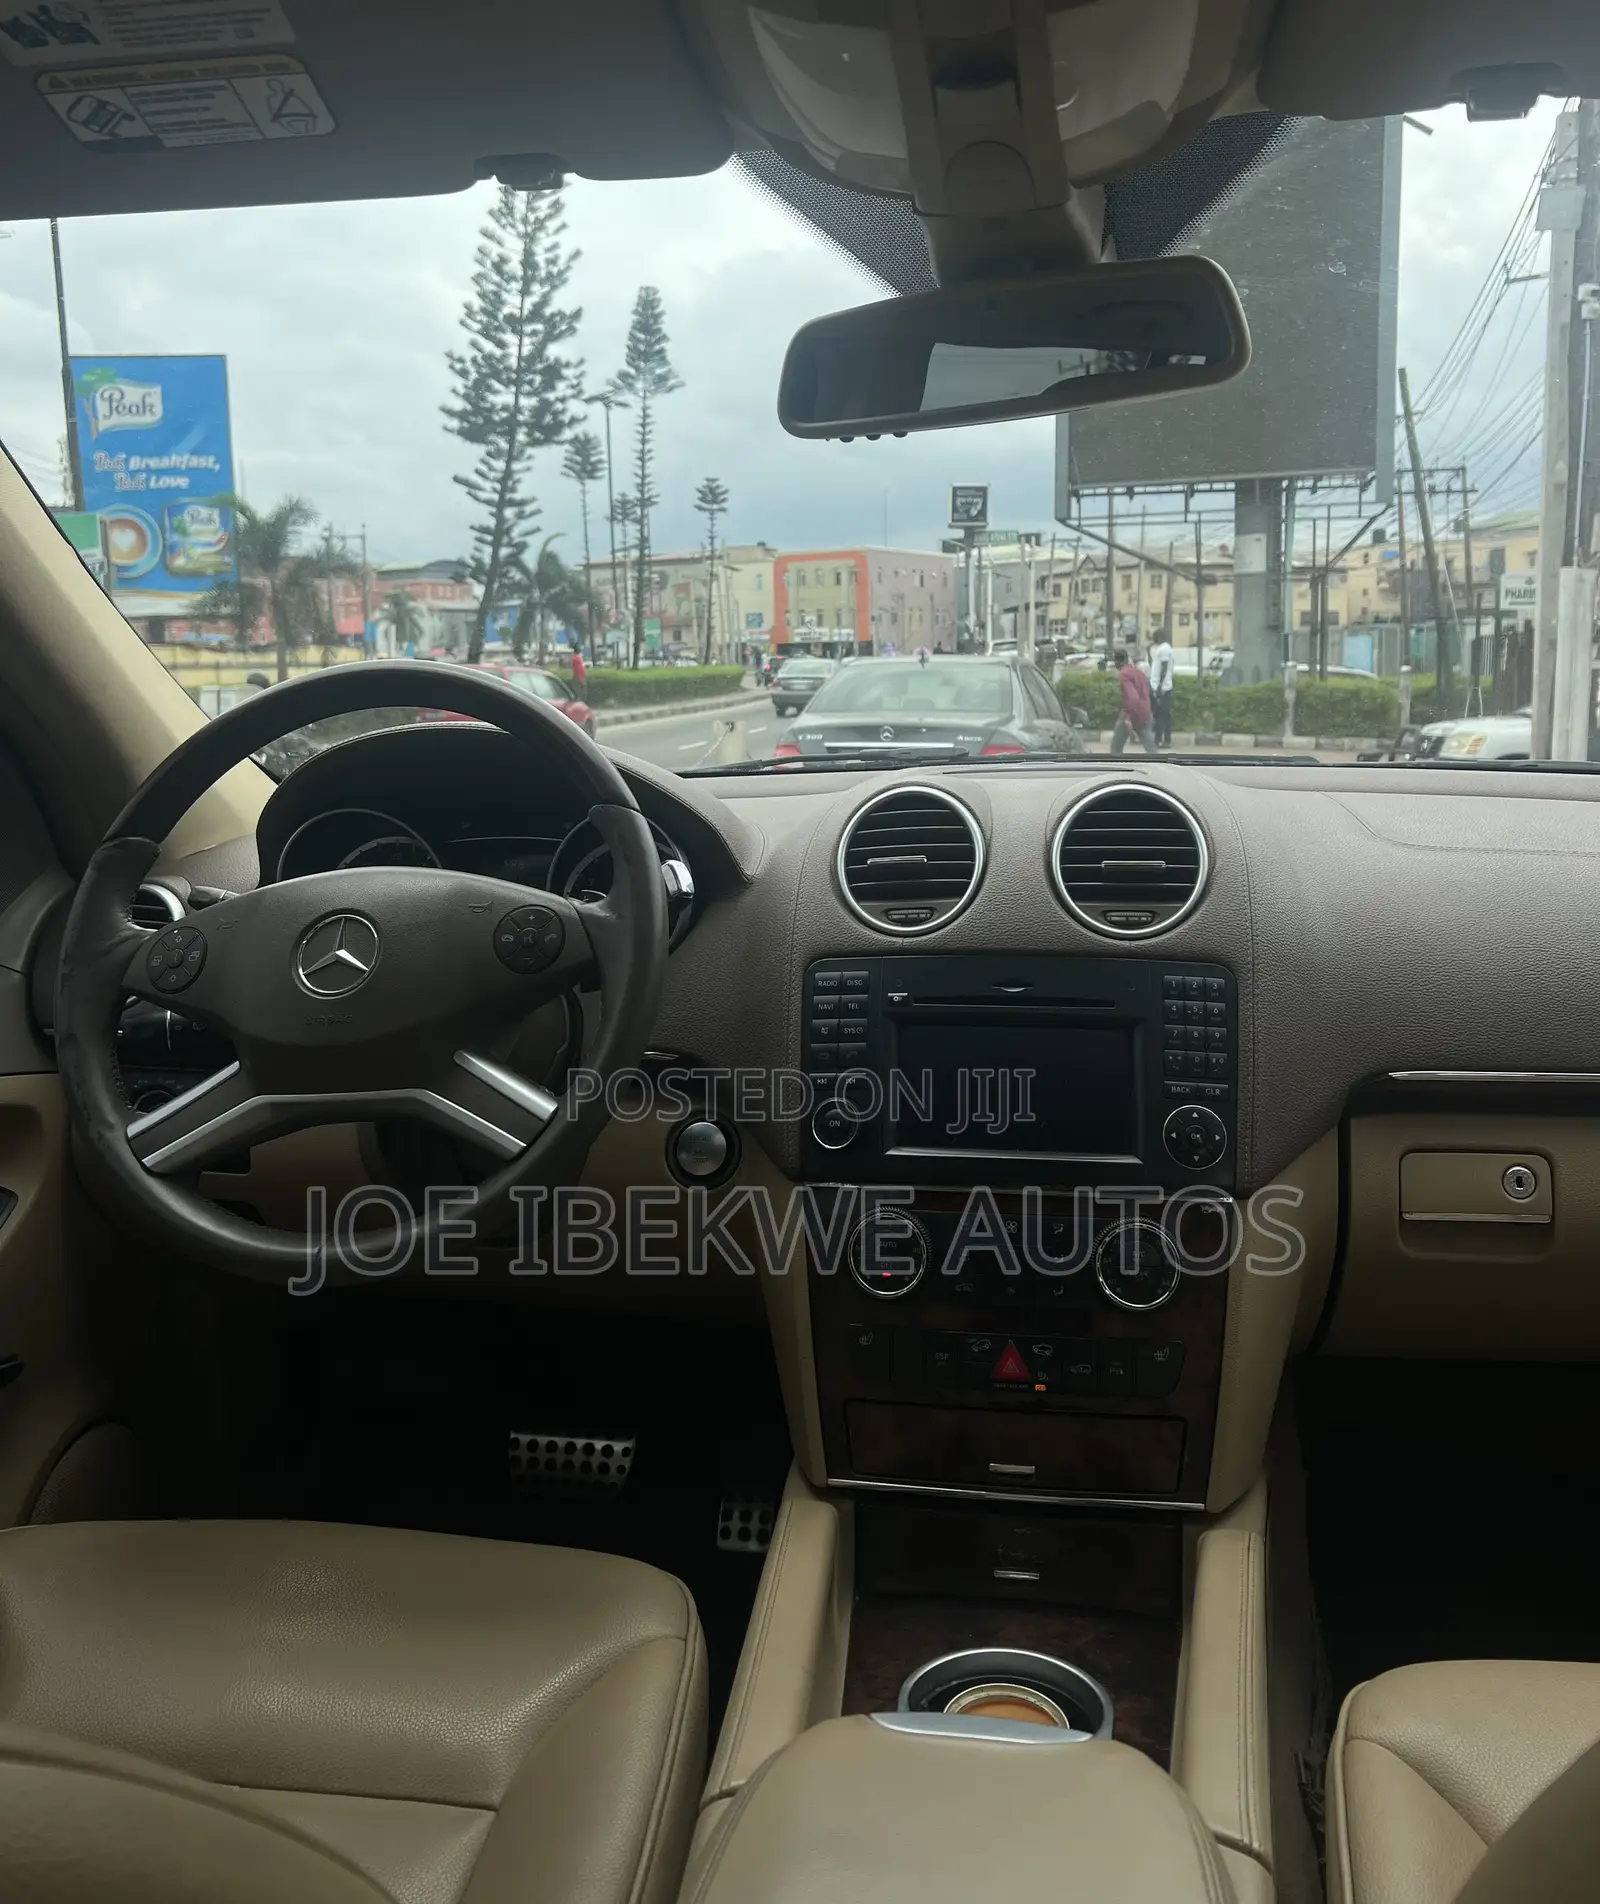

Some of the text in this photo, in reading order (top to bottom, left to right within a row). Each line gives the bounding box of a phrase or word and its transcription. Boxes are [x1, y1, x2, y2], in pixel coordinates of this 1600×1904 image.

[99, 386, 157, 420] Peak
[95, 451, 220, 472] Peak Breakfast,
[115, 471, 147, 491] Peak
[1212, 982, 1218, 990] 3
[1192, 1005, 1198, 1013] 5
[1172, 1029, 1178, 1037] 7
[1171, 1085, 1191, 1094] BACK
[1205, 1087, 1221, 1096] CLR
